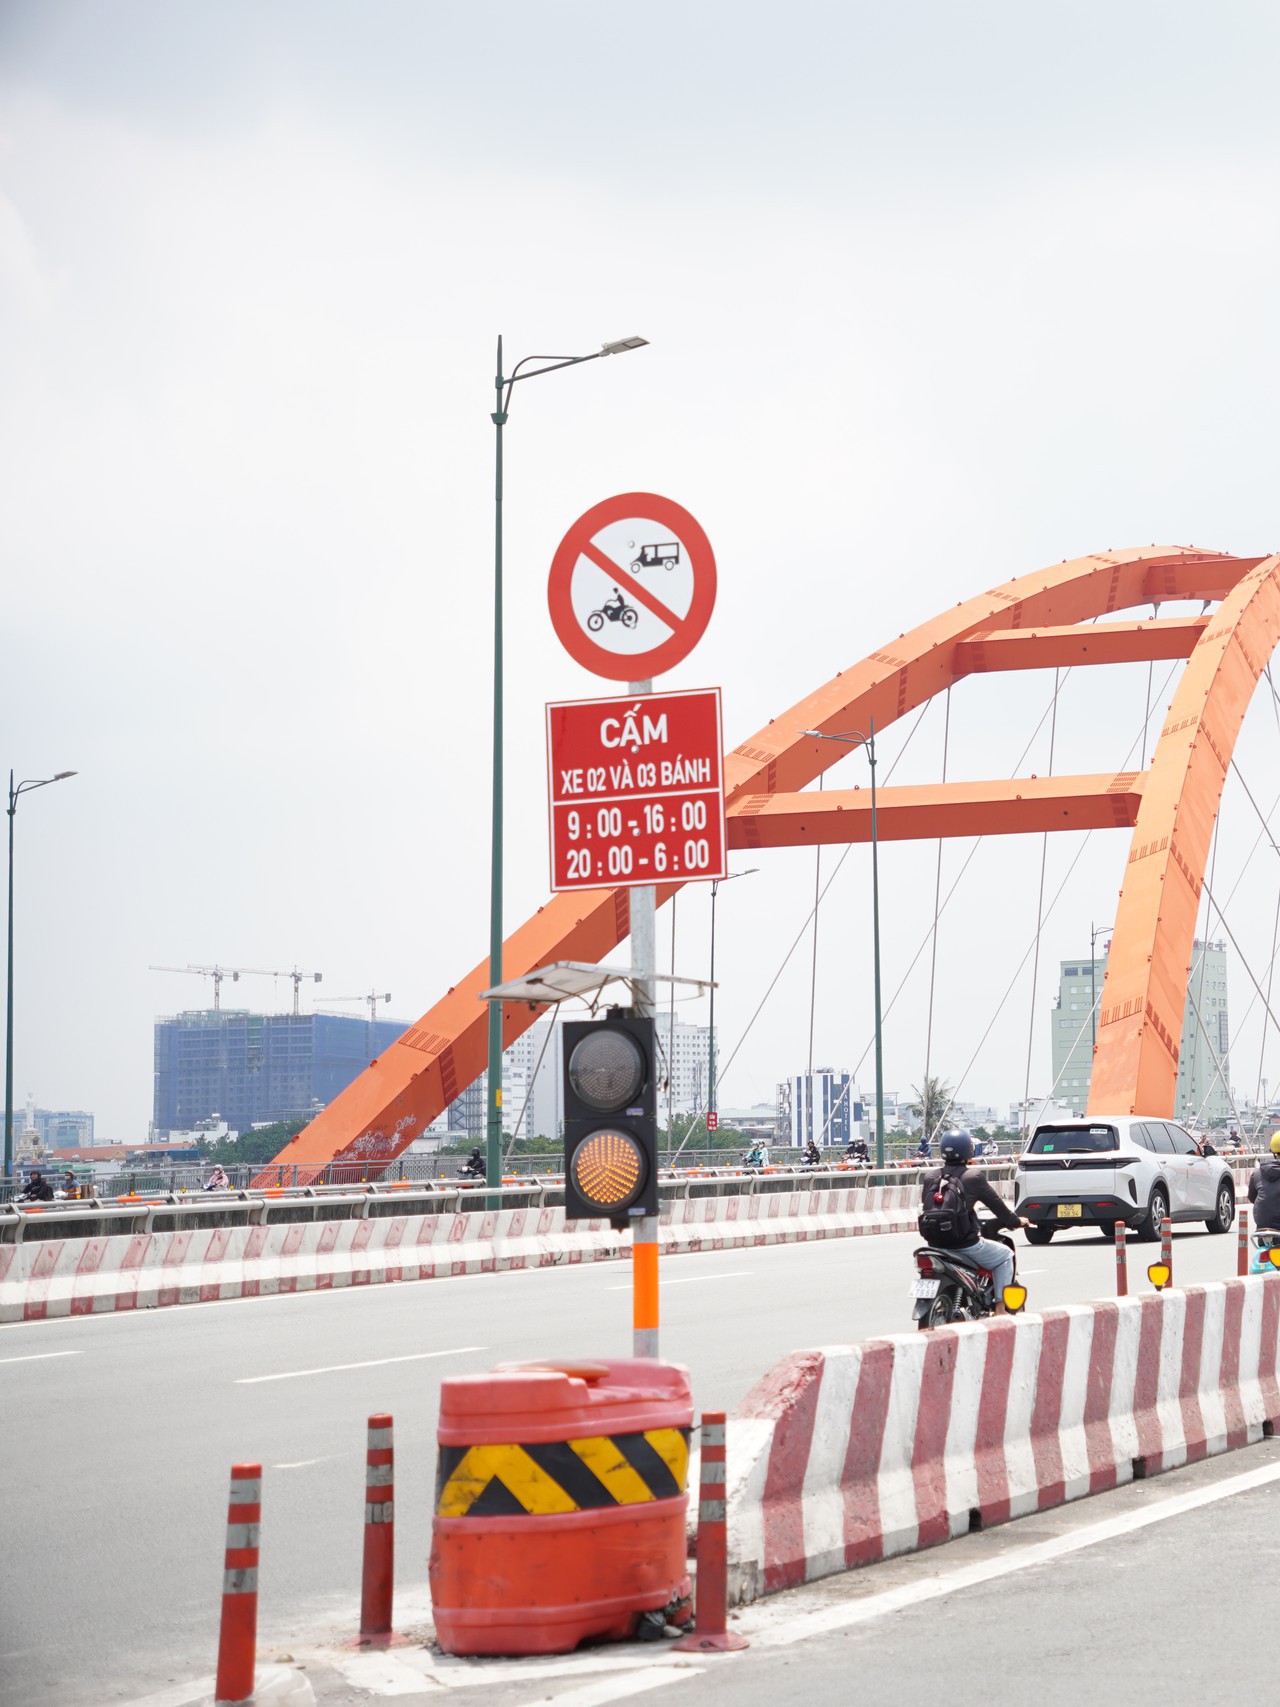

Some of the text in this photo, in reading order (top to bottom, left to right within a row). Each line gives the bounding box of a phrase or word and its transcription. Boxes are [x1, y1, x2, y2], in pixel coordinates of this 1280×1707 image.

[600, 703, 668, 748] CẤM
[561, 754, 711, 795] XE 02 VÀ 03 BÁNH
